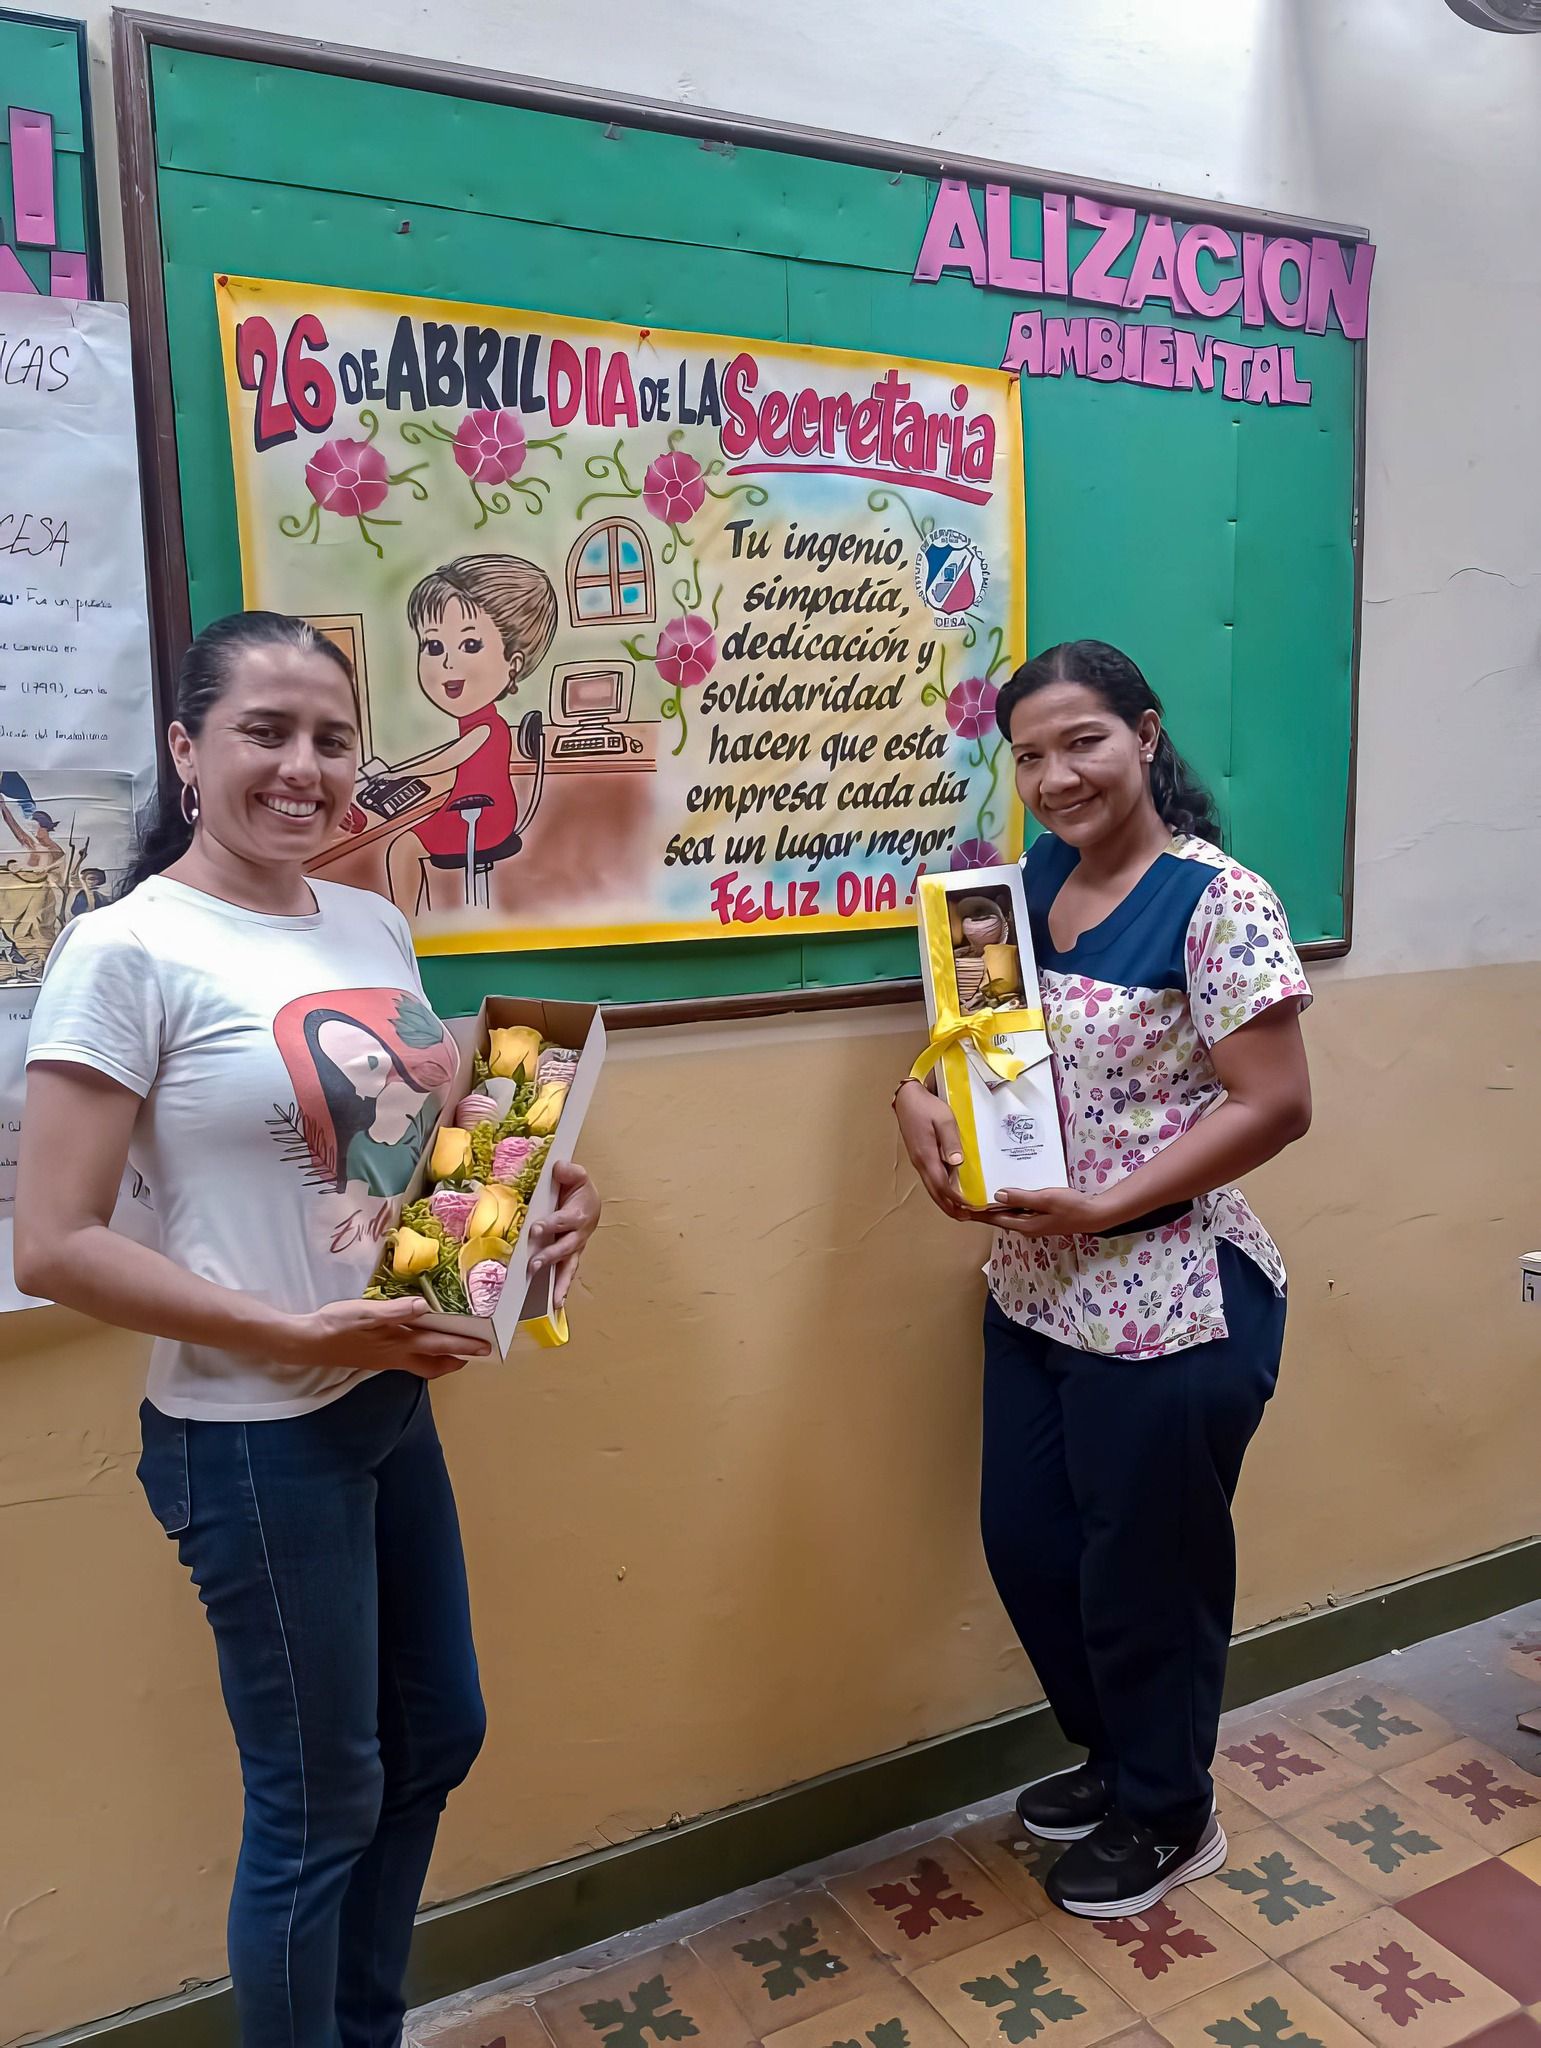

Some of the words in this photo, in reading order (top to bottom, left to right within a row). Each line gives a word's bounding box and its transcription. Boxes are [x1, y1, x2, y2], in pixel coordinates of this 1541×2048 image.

[913, 178, 1376, 340] ALIZACION
[0, 333, 69, 392] ICAS
[1000, 310, 1312, 406] AMBIENTAL
[236, 314, 336, 452] 26
[340, 349, 385, 405] DE
[386, 315, 546, 413] ABRIL
[548, 339, 638, 428] DIA
[638, 376, 671, 422] DE
[678, 357, 722, 427] LA
[719, 352, 996, 483] Secretaria
[723, 519, 771, 560] Tu
[784, 522, 909, 573] ingenio,
[743, 574, 910, 624] simpatía,
[721, 621, 910, 666] dedicación
[915, 639, 936, 675] y
[700, 671, 906, 715] solidaridad
[708, 724, 812, 765] hacen
[820, 729, 879, 771] que
[883, 724, 950, 761] esta
[686, 780, 829, 823] empresa
[837, 773, 915, 811] cada
[918, 770, 971, 805] día
[663, 831, 715, 866] sea
[724, 832, 767, 866] un
[774, 824, 862, 872] lugar
[865, 824, 955, 866] mejor.
[710, 870, 820, 926] FELIZ
